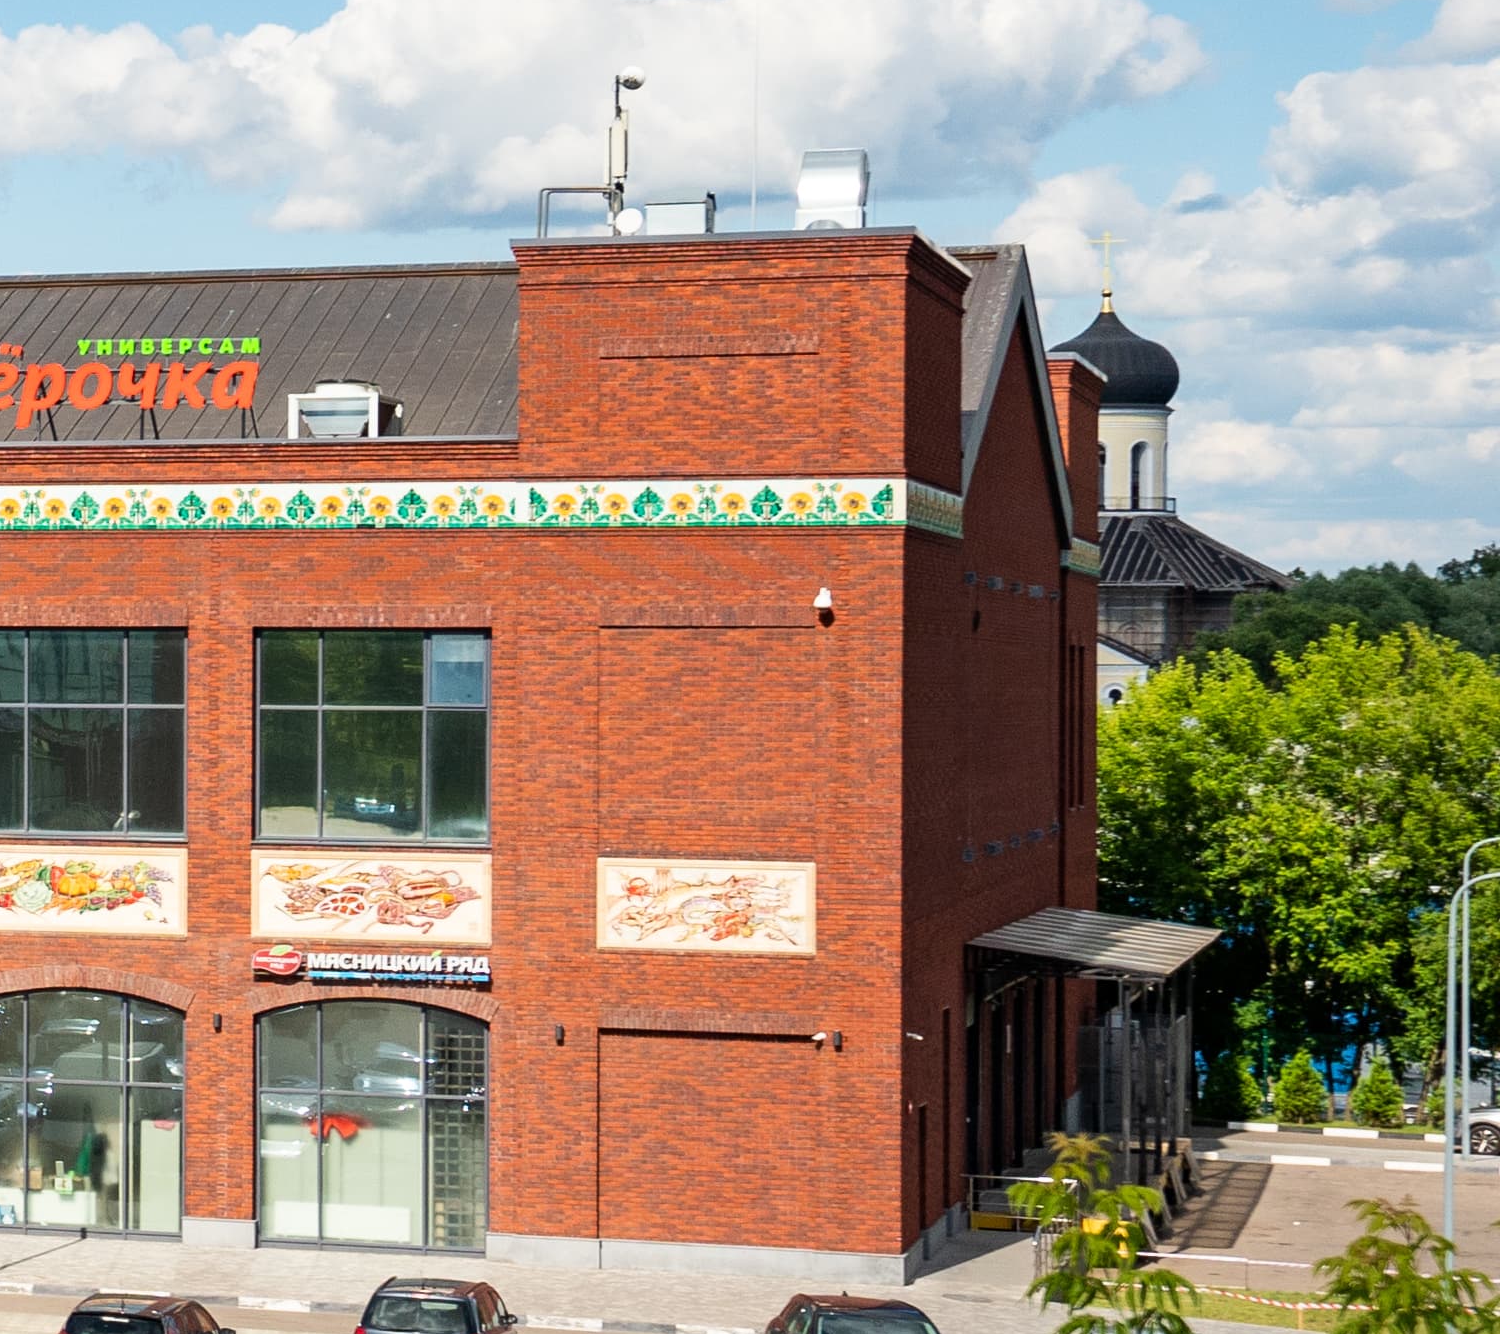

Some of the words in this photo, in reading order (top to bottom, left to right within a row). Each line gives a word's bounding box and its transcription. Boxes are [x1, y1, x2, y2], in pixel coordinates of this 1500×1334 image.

[77, 336, 261, 355] УНИВЕРСАМ
[308, 951, 442, 971] МЯСНИЦКИЙ
[446, 956, 490, 973] РЯД
